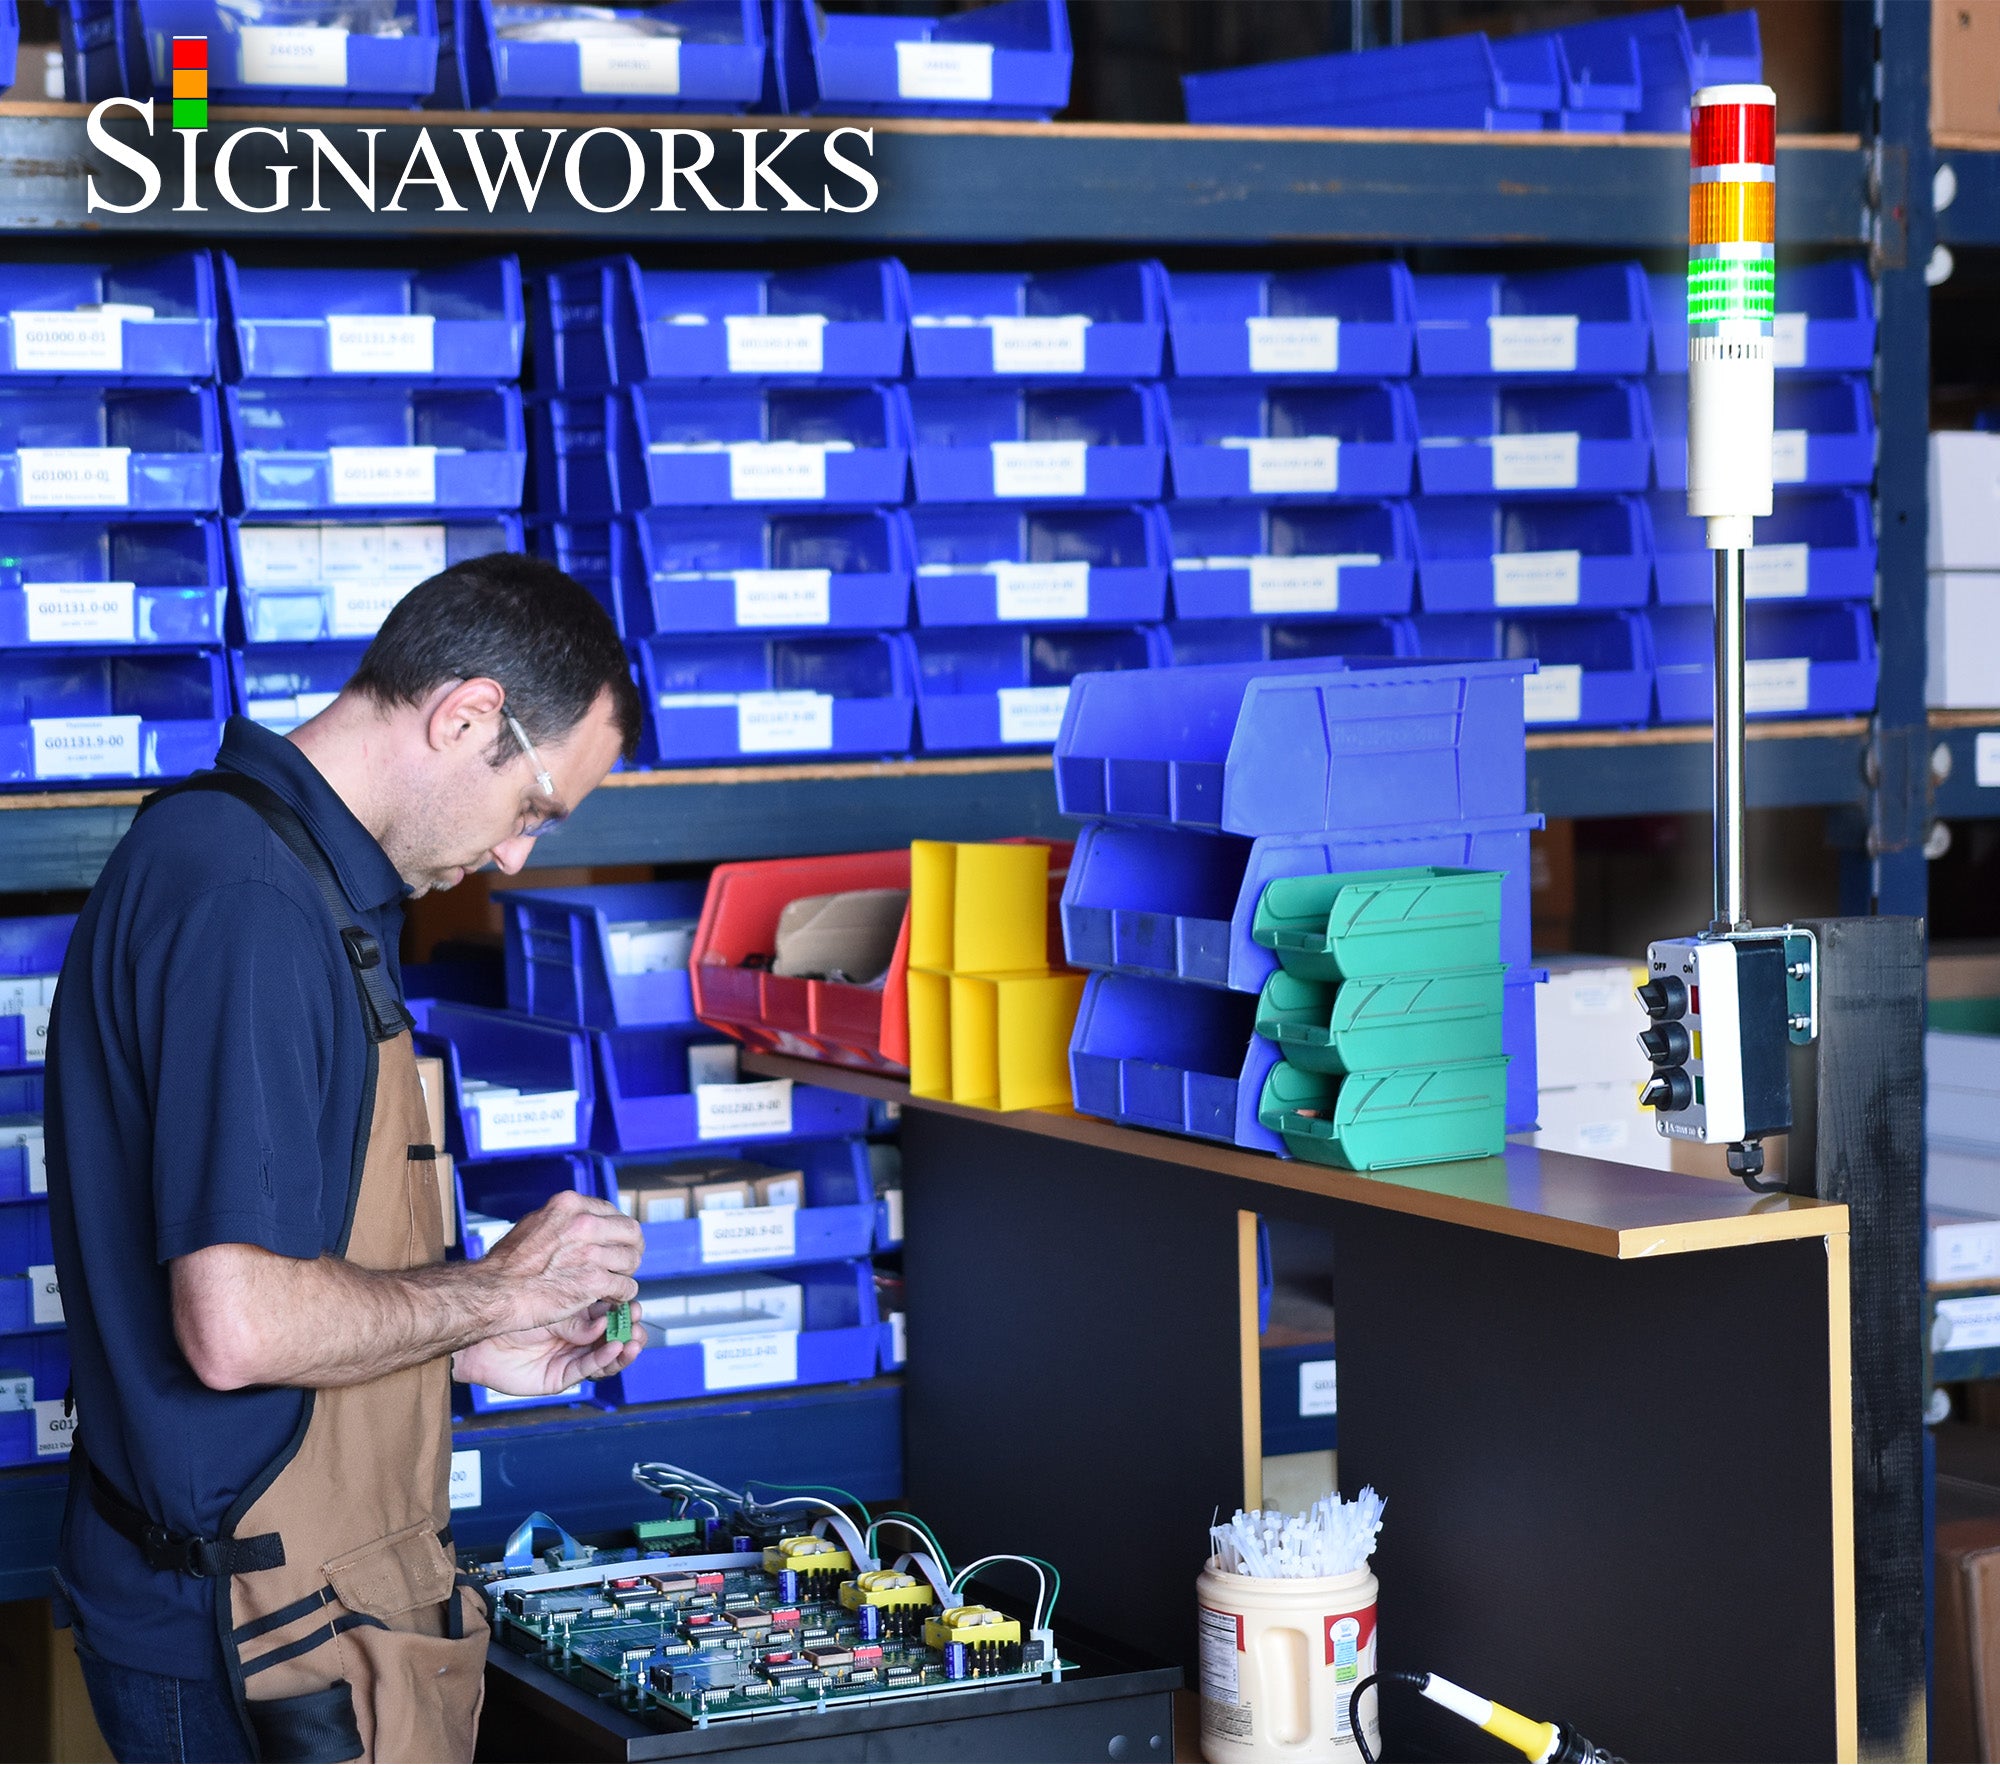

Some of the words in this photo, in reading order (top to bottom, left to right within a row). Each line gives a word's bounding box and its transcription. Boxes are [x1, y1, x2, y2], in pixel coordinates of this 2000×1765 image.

[44, 734, 125, 749] G01131.9-00
[1652, 961, 1668, 972] OFF
[1681, 963, 1695, 975] ON
